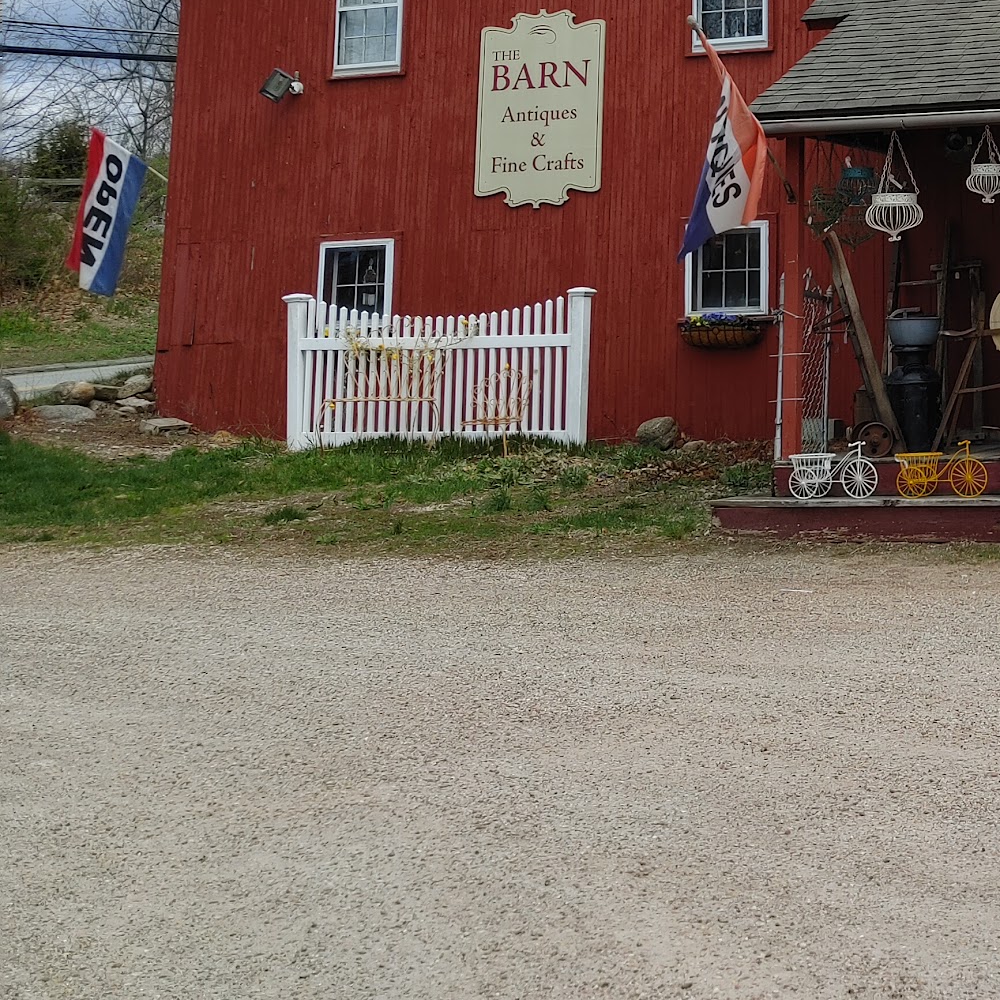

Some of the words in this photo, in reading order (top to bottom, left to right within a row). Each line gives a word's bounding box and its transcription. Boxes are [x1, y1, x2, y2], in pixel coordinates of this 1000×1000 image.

[492, 49, 521, 62] THE
[490, 59, 591, 92] BARN
[501, 105, 578, 127] Antiques
[530, 131, 546, 147] &
[490, 156, 527, 174] Fine
[532, 152, 585, 172] Crafts
